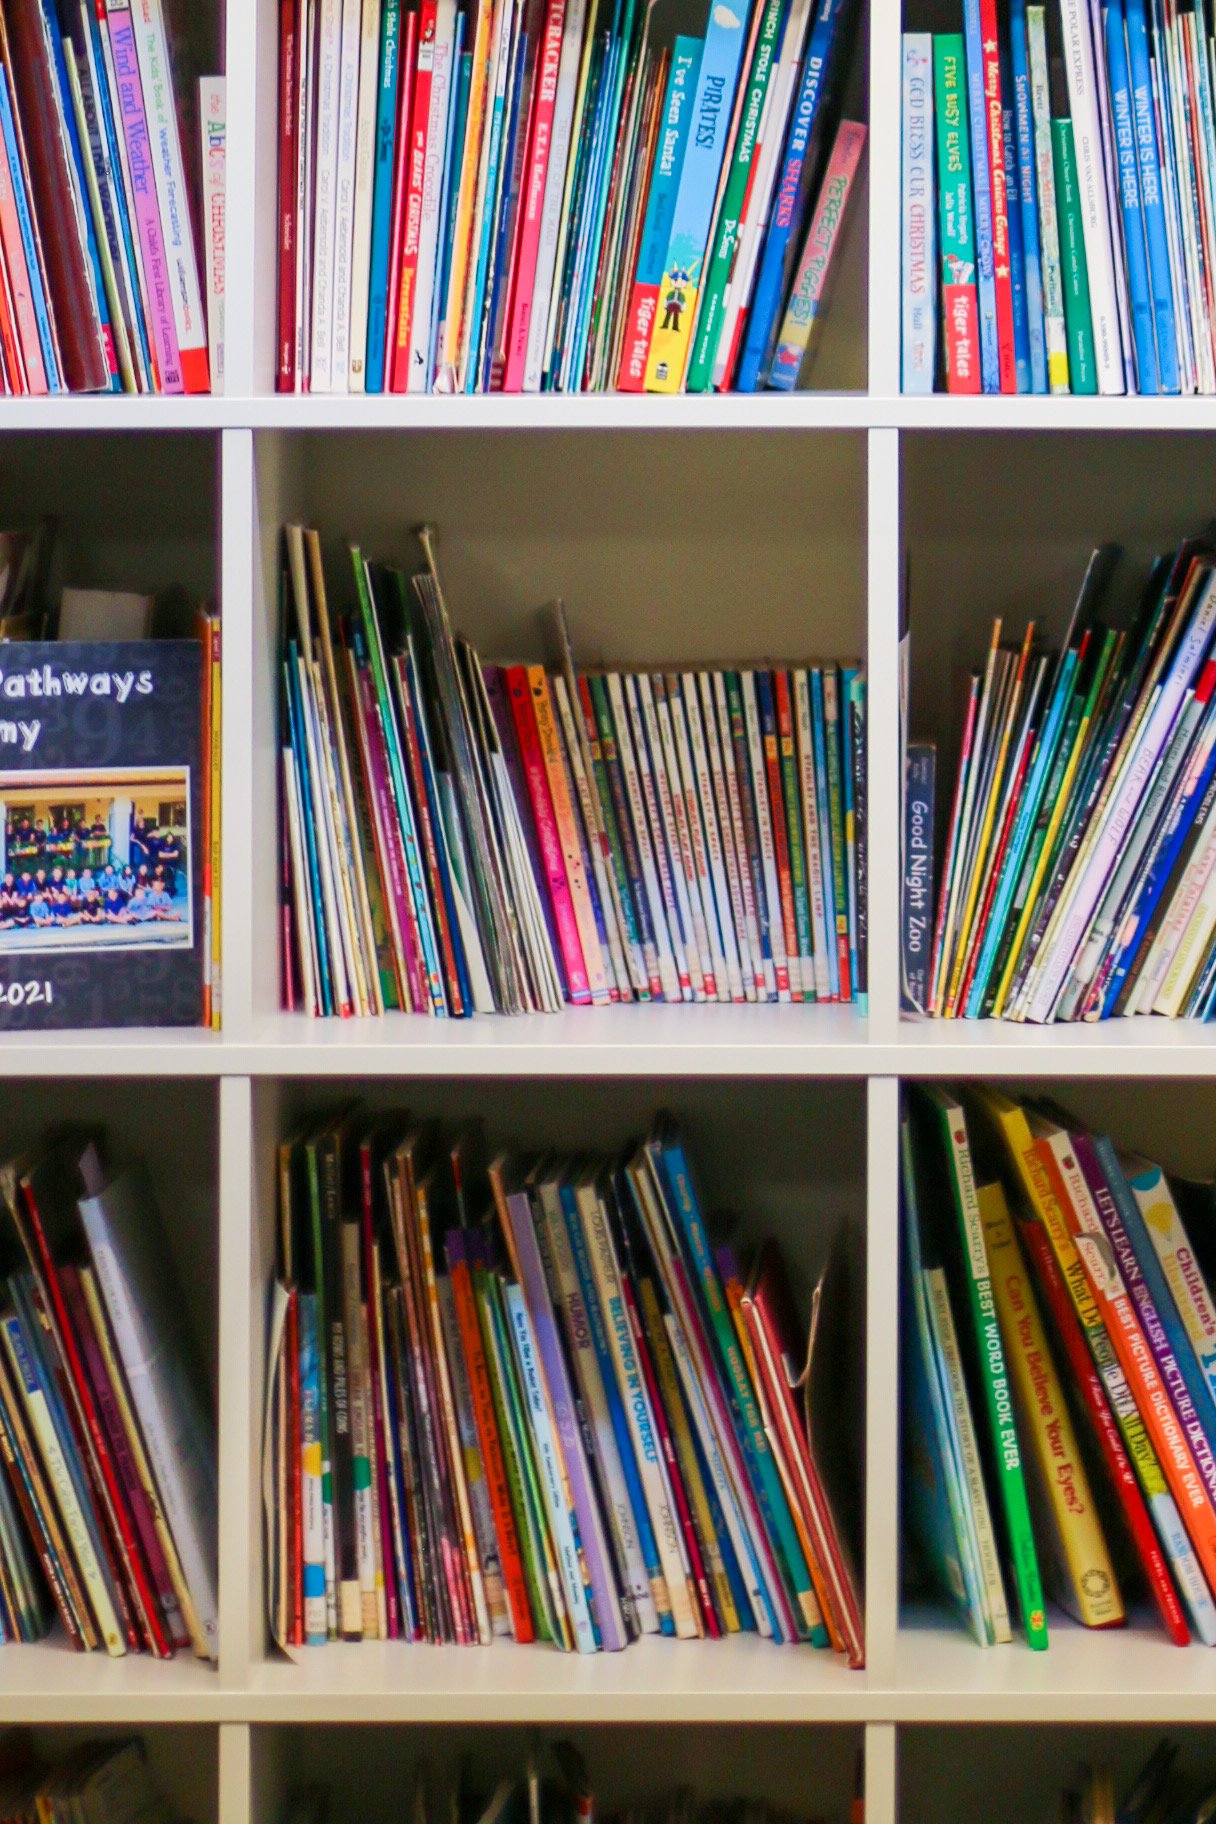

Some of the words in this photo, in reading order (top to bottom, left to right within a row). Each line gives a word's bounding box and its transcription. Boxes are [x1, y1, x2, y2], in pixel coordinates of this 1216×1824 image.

[386, 11, 397, 37] Stole
[1068, 11, 1080, 46] POLAR
[112, 26, 136, 76] Wind
[384, 39, 397, 88] Christmas
[674, 55, 693, 86] I've
[754, 44, 772, 82] STOLE
[944, 56, 958, 88] FIVE
[1072, 49, 1085, 96] EXPRESS
[121, 82, 142, 115] and
[909, 76, 924, 109] GOD
[985, 60, 999, 98] Merry
[668, 90, 686, 124] Seen
[695, 75, 726, 150] PIRATES!
[739, 88, 762, 163] CHRISTMAS
[791, 56, 822, 151] DISCOVER
[945, 95, 960, 126] BUSY
[1014, 75, 1030, 143] SNOWMEN
[1114, 88, 1135, 147] WINTER
[1135, 85, 1154, 145] WINTER
[126, 119, 151, 195] Weather
[147, 33, 158, 53] The
[153, 84, 165, 109] Book
[159, 128, 173, 178] Weather
[166, 180, 183, 247] Forecasting
[659, 128, 679, 177] Santa!
[909, 115, 925, 160] BLESS
[946, 131, 962, 171] ELVES
[1120, 150, 1135, 165] IS
[1140, 147, 1156, 164] IS
[527, 163, 545, 221] Hoffmann
[777, 158, 802, 227] SHARKS
[992, 168, 1006, 213] Curious
[1021, 165, 1033, 204] NIGHT
[1122, 167, 1139, 209] HERE
[1142, 165, 1159, 205] HERE
[404, 193, 422, 255] CHRISTMAS
[815, 175, 848, 249] PERFECT
[908, 204, 926, 294] CHRISTMAS
[994, 215, 1009, 256] George
[398, 267, 414, 347] Berenstains
[636, 296, 656, 336] tiger
[953, 296, 969, 334] tiger
[630, 338, 646, 377] tales
[955, 338, 973, 377] tales
[0, 664, 153, 703] athways
[910, 800, 928, 848] Good
[905, 854, 928, 910] Night
[909, 916, 926, 953] Zoo
[976, 1280, 996, 1319] BEST
[1065, 1260, 1092, 1305] What
[1094, 1187, 1118, 1227] LET'S
[1109, 1227, 1140, 1281] LEARN
[1132, 1285, 1169, 1353] ENGLISH
[1159, 1353, 1195, 1420] PICTURE
[609, 1296, 640, 1372] BELIEVING
[1083, 1308, 1104, 1329] Do
[985, 1323, 1007, 1375] WORD
[1093, 1330, 1121, 1381] People
[627, 1374, 642, 1389] IN
[992, 1378, 1012, 1426] BOOK
[1005, 1275, 1026, 1312] Can
[1017, 1315, 1036, 1349] You
[1027, 1352, 1055, 1416] Believe
[1045, 1419, 1069, 1458] Your
[1057, 1463, 1085, 1515] Eyes?
[1113, 1298, 1134, 1330] BEST
[1127, 1333, 1156, 1390] PICTURE
[1150, 1398, 1194, 1470] DICTIONARY
[1183, 1473, 1205, 1509] EVER
[631, 1391, 659, 1465] YOURSELF
[1001, 1429, 1020, 1470] EVER
[1126, 1432, 1159, 1467] Day?
